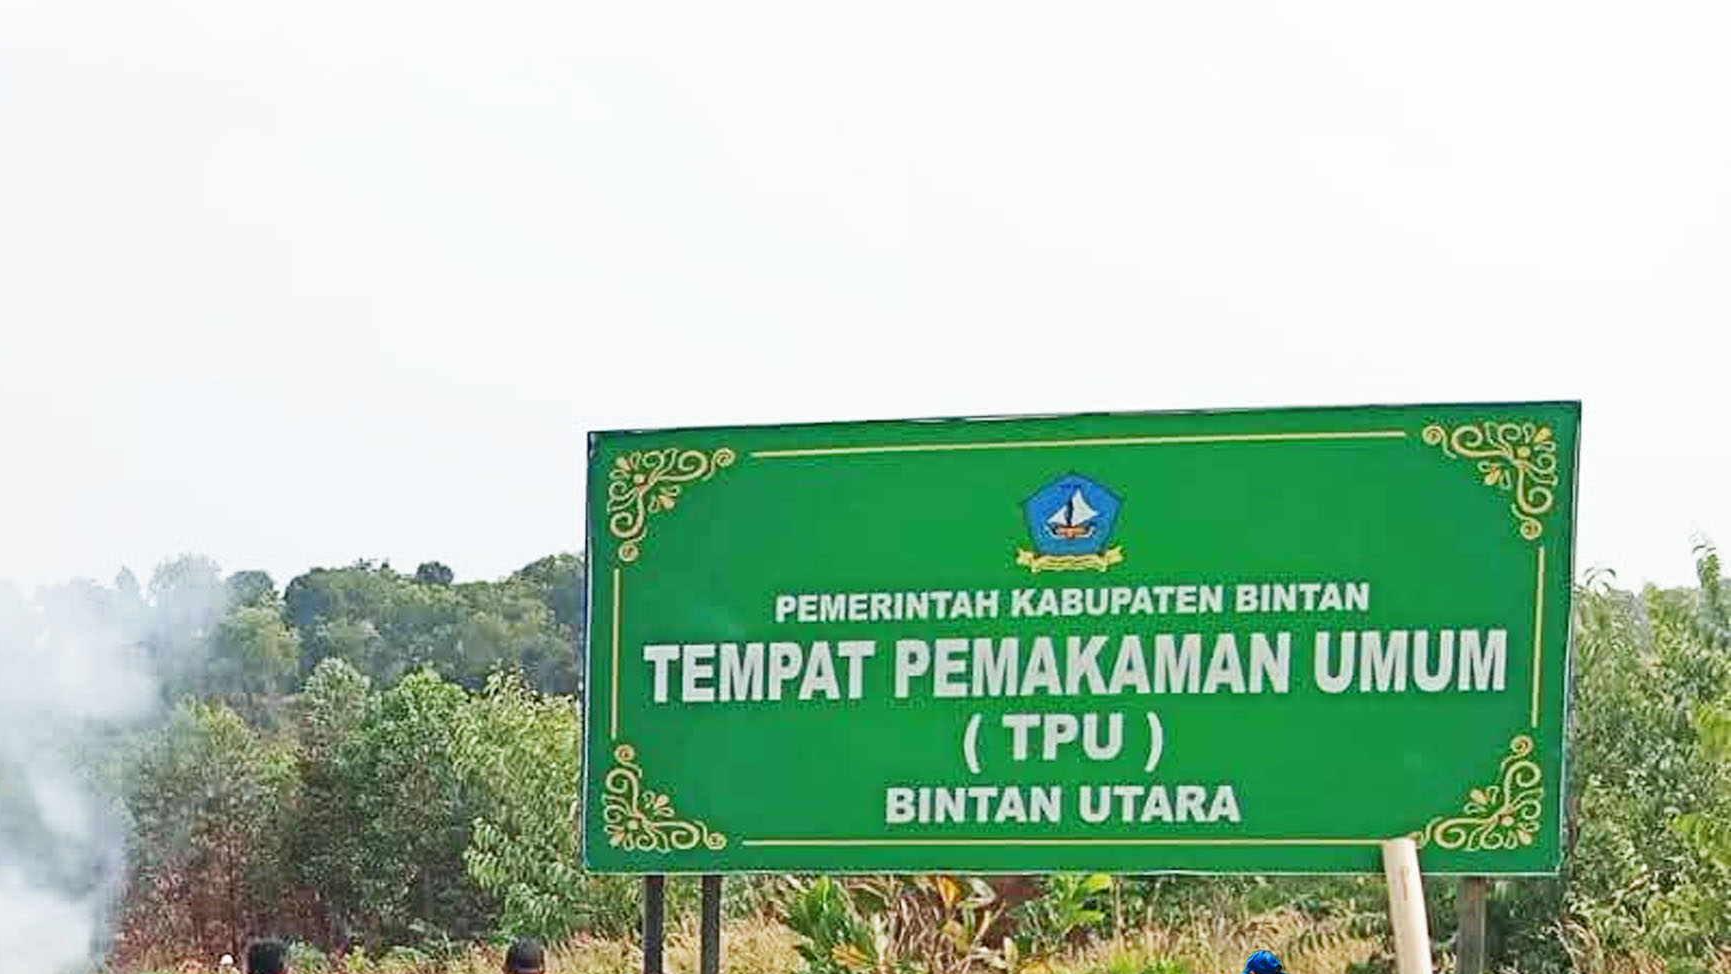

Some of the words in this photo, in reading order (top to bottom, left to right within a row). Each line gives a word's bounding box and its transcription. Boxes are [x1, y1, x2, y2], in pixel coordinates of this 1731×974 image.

[775, 589, 999, 623] PEMERINTAH
[1011, 584, 1224, 617] KABUPATEN
[1235, 582, 1370, 613] BINTAN
[643, 639, 877, 703] TEMPAT
[894, 631, 1291, 698] PEMAKAMAN
[1314, 628, 1508, 694] UMUM
[1002, 712, 1123, 761] TPU
[885, 785, 1062, 824] BINTAN
[1079, 784, 1241, 823] UTARA
